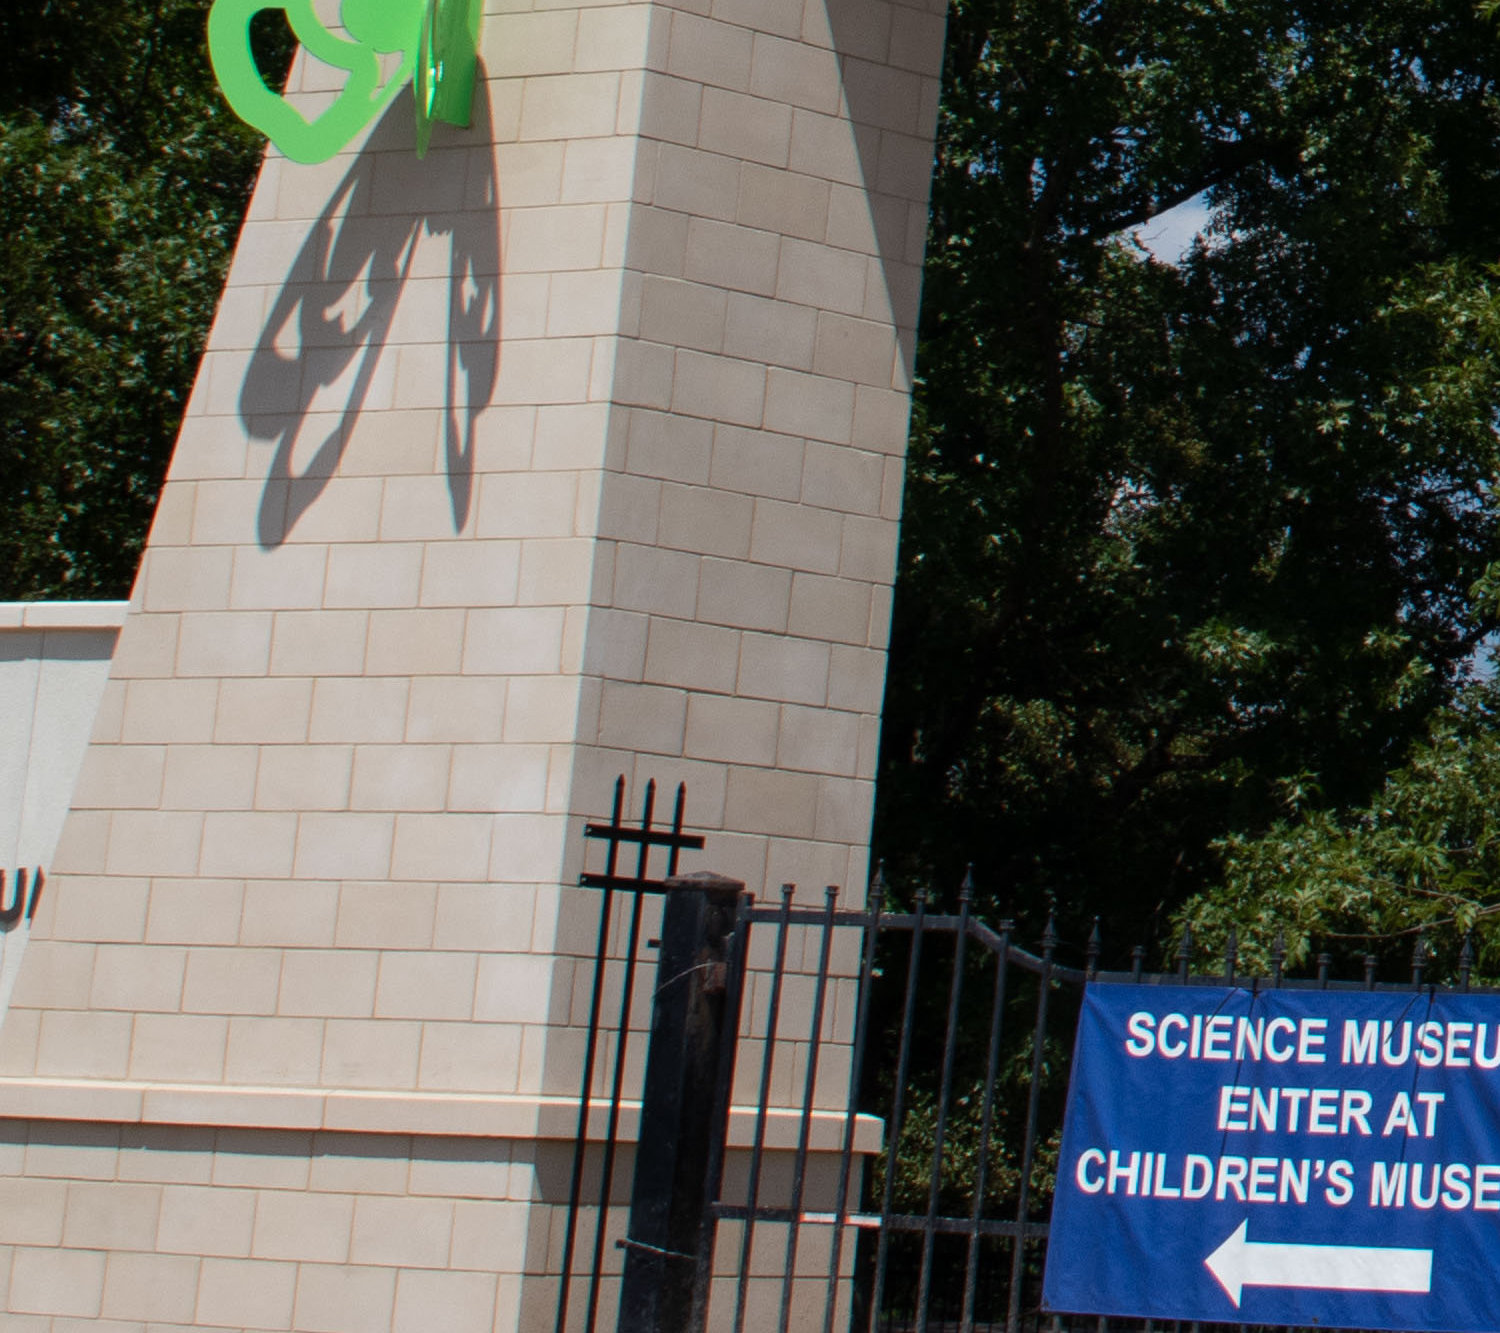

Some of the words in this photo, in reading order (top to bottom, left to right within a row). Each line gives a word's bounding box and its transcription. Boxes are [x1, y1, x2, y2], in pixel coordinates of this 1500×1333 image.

[1126, 1012, 1328, 1063] SCIENCE
[1217, 1086, 1373, 1135] ENTER
[1383, 1091, 1445, 1137] AT
[1076, 1148, 1354, 1206] CHILDREN'S
